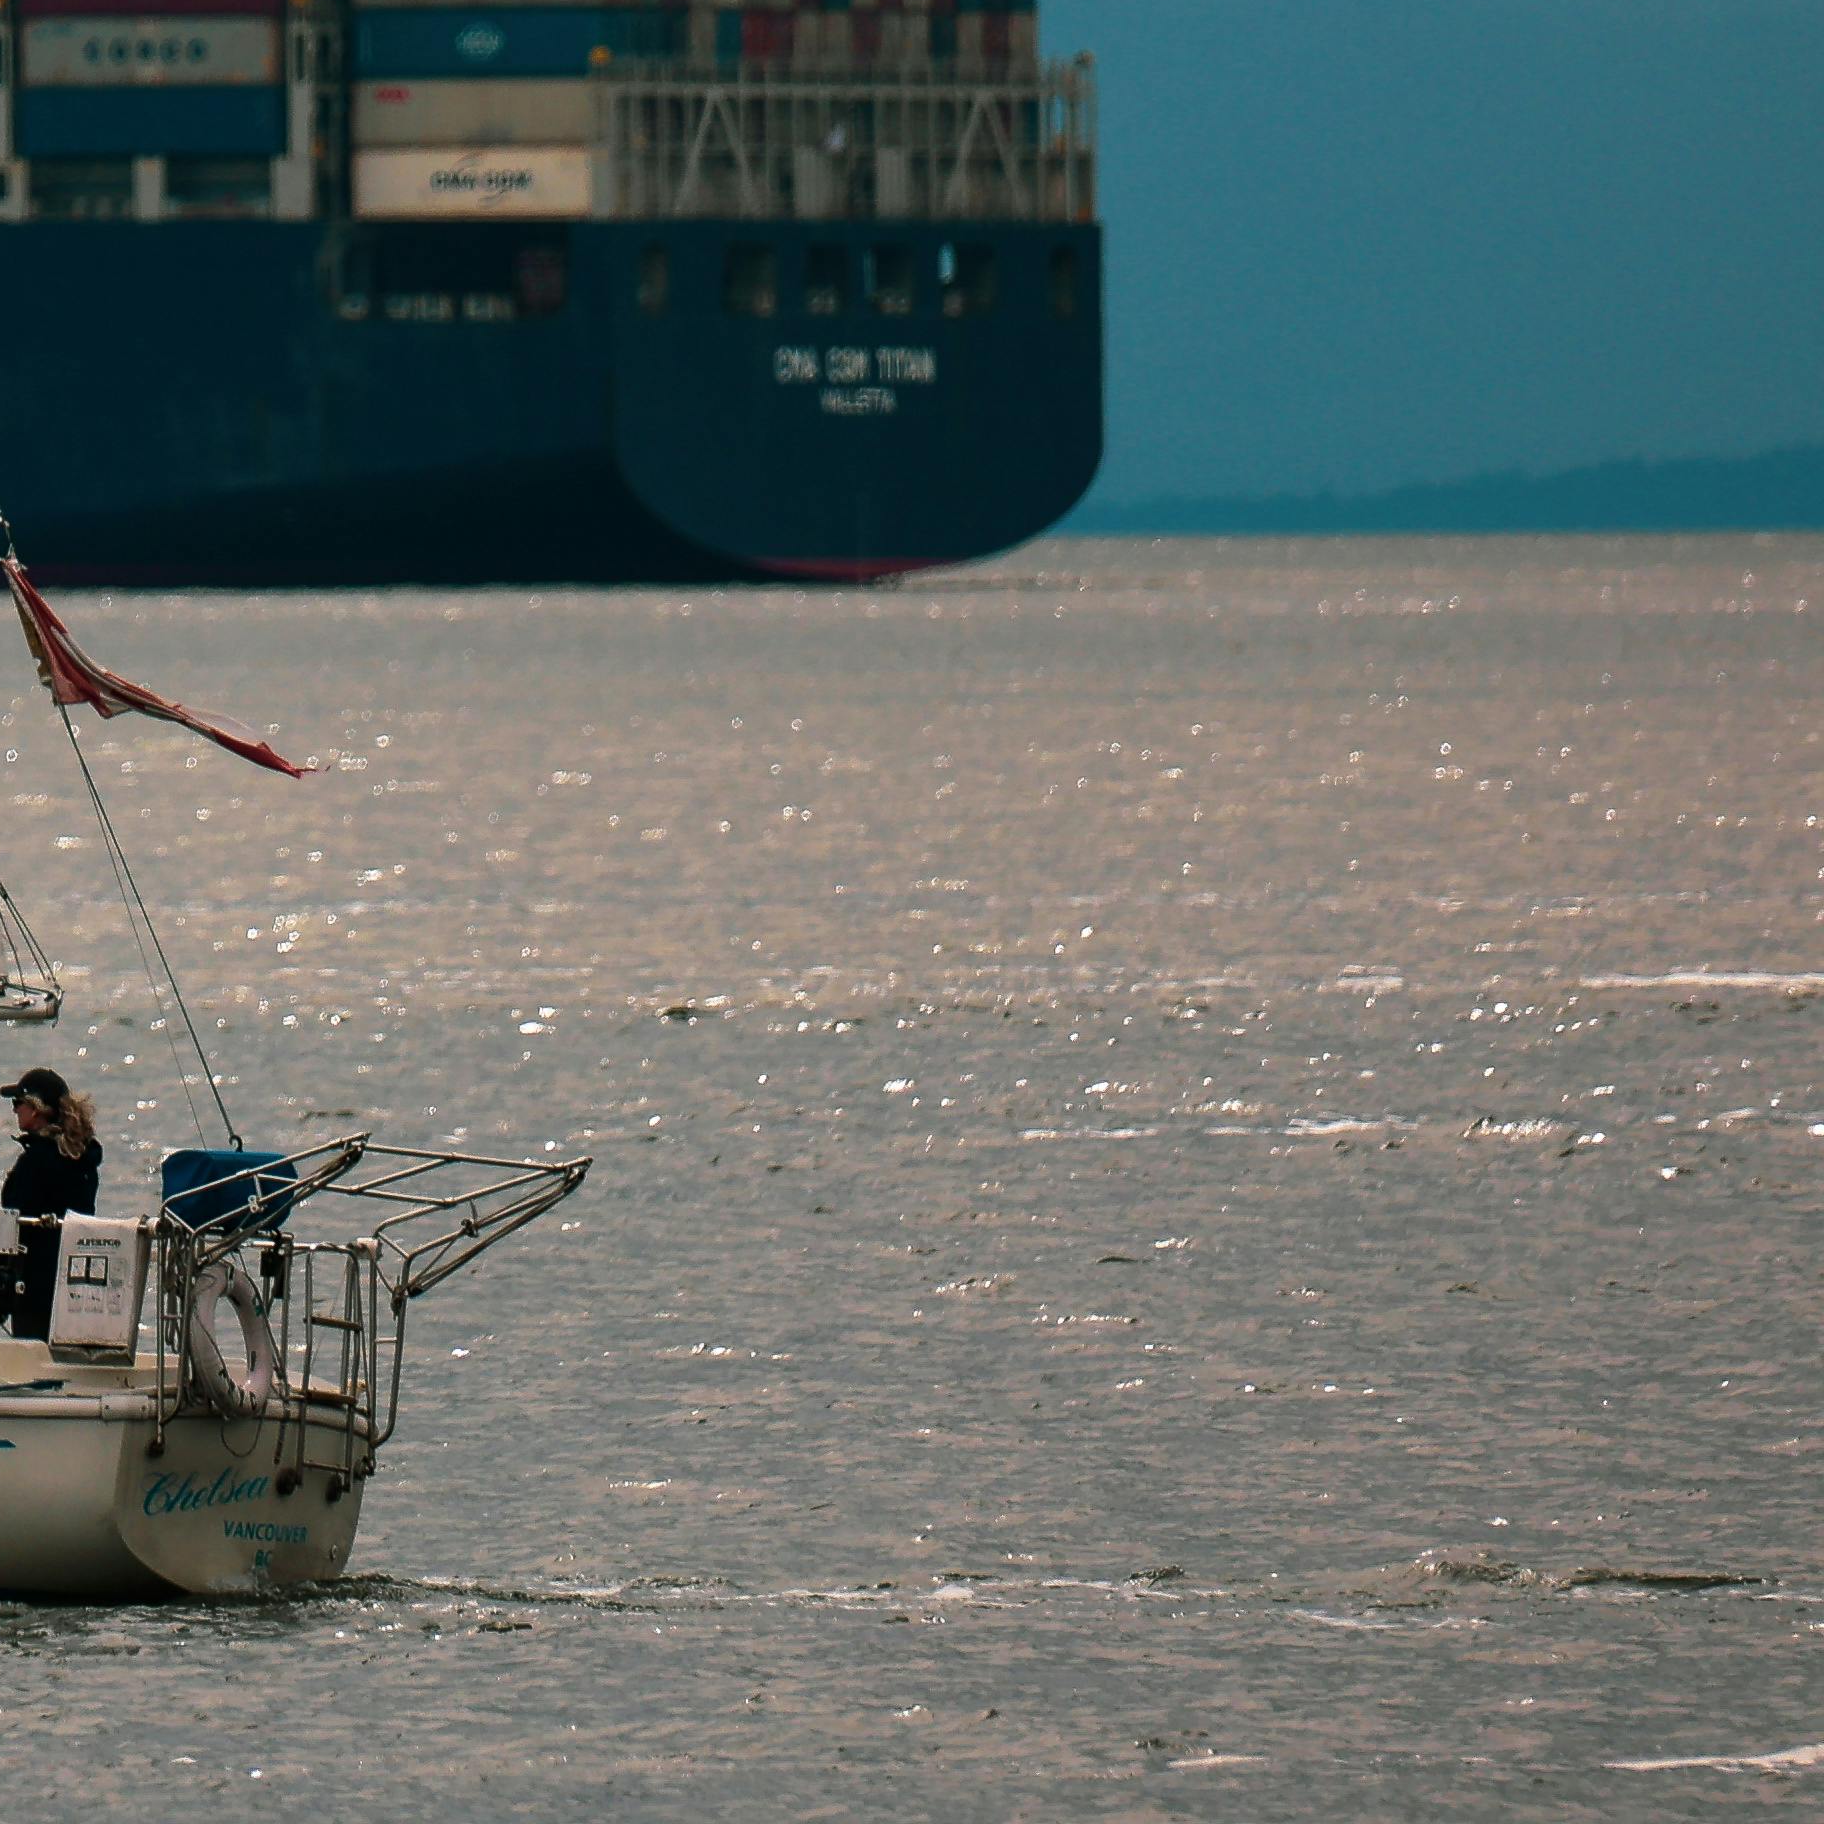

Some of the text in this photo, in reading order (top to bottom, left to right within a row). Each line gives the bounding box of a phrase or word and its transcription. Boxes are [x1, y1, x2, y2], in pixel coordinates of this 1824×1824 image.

[143, 1466, 270, 1516] Chelsea
[223, 1520, 308, 1544] VANCOUVER
[254, 1549, 273, 1569] BC
